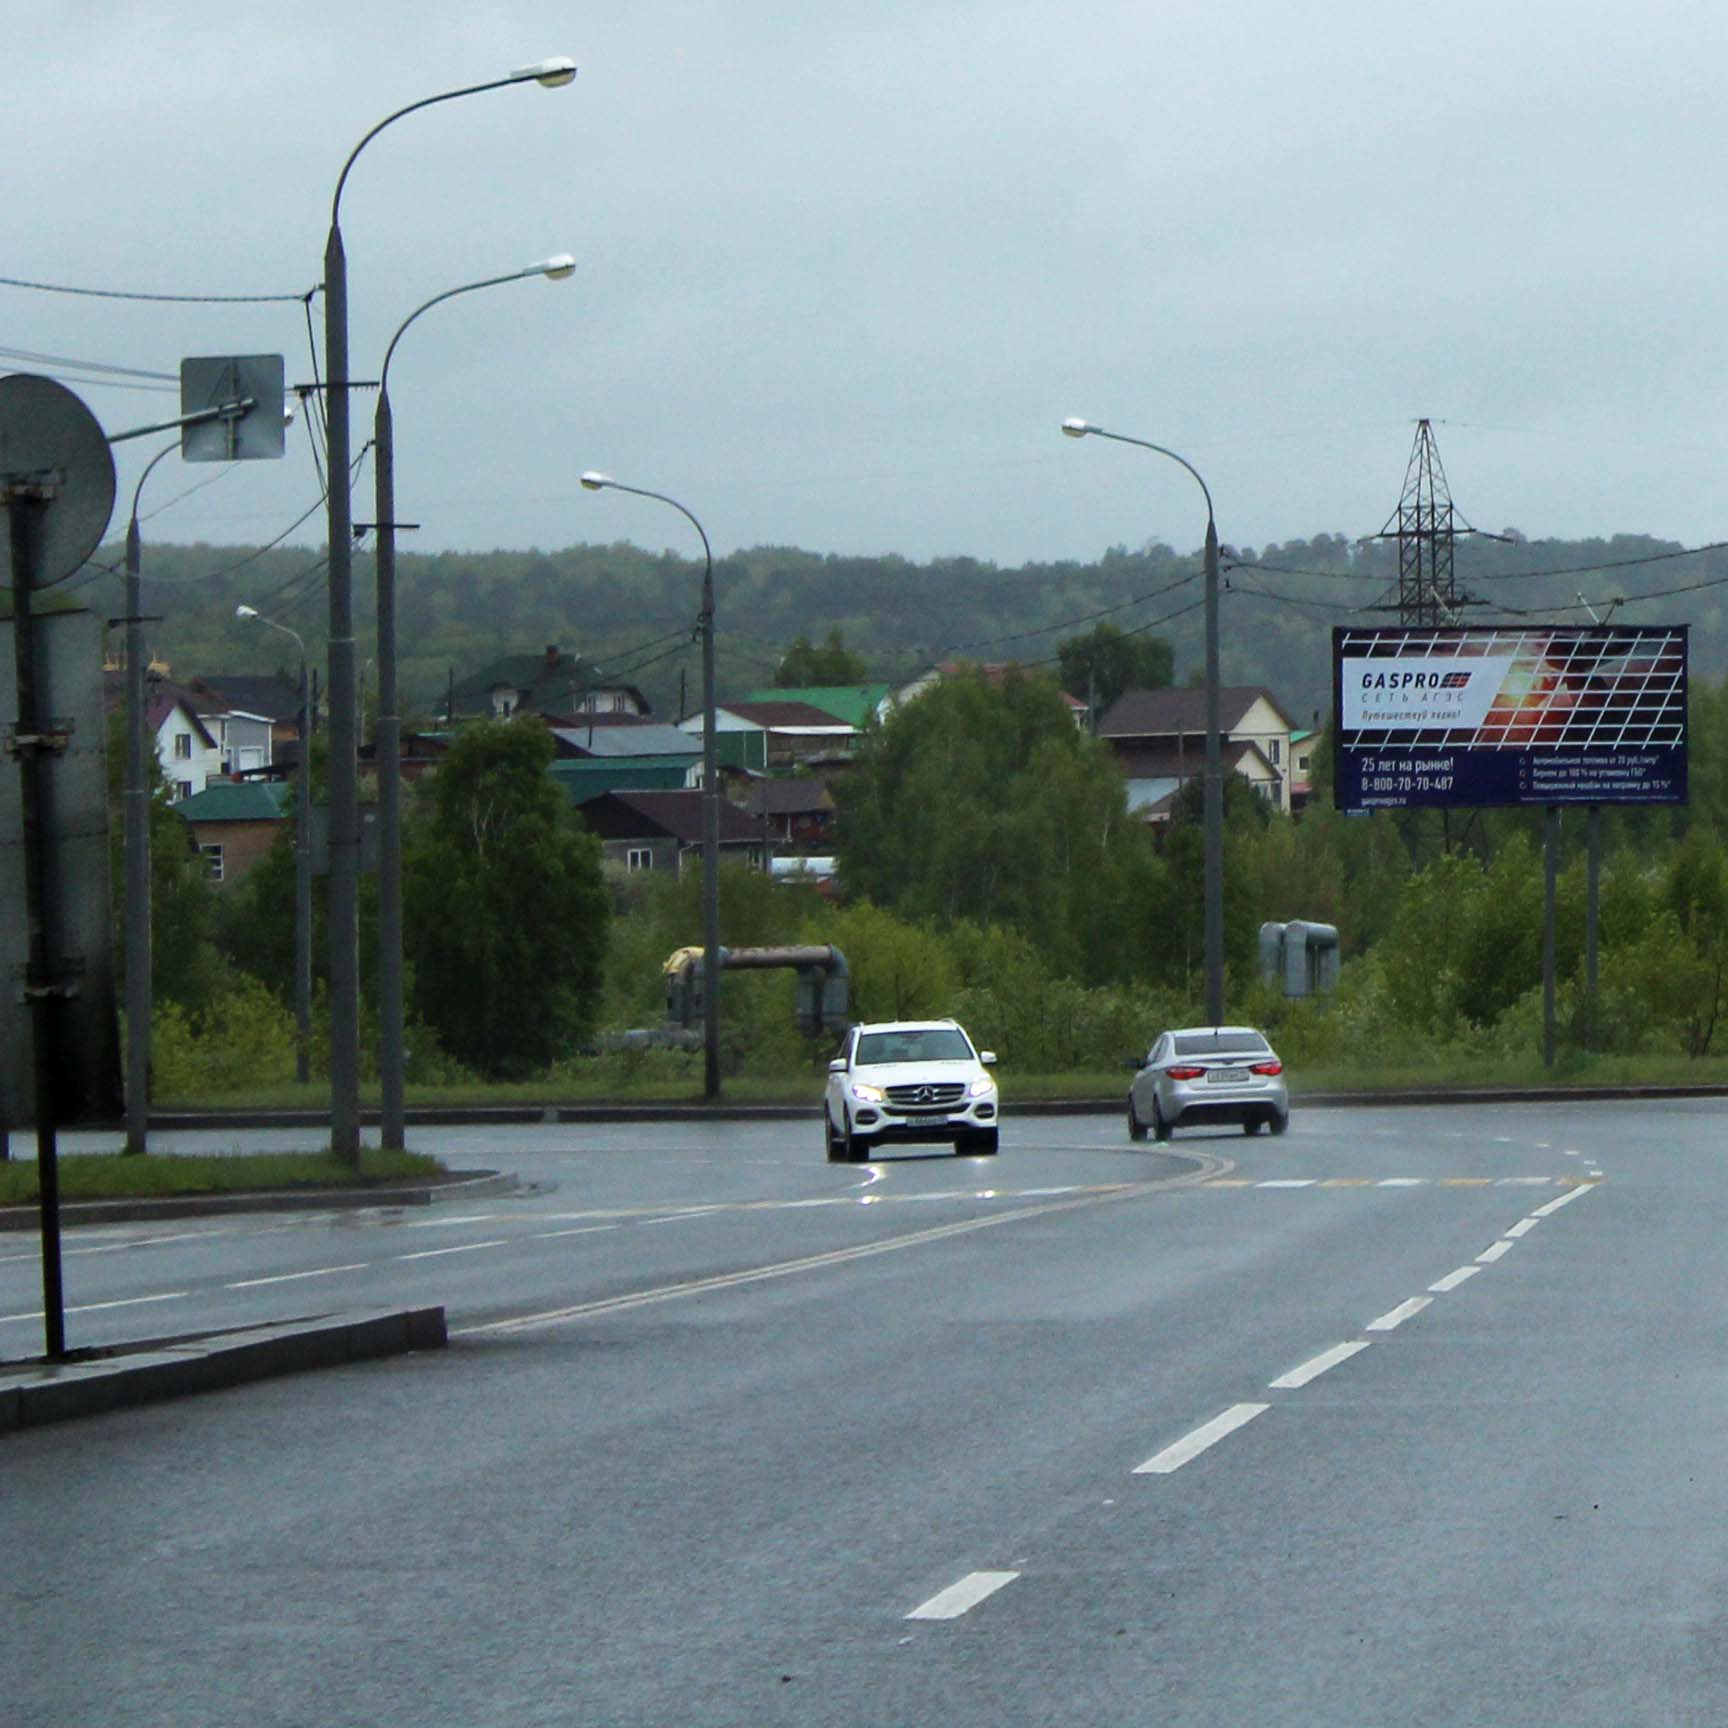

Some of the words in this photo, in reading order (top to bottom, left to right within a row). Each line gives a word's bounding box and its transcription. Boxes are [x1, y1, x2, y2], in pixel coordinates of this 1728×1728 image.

[1362, 672, 1439, 689] GASPRO
[1361, 694, 1408, 703] СЕТЬ
[1362, 758, 1375, 772] 25
[1379, 760, 1398, 772] лет
[1401, 760, 1412, 771] на
[1415, 758, 1454, 774] рынке!
